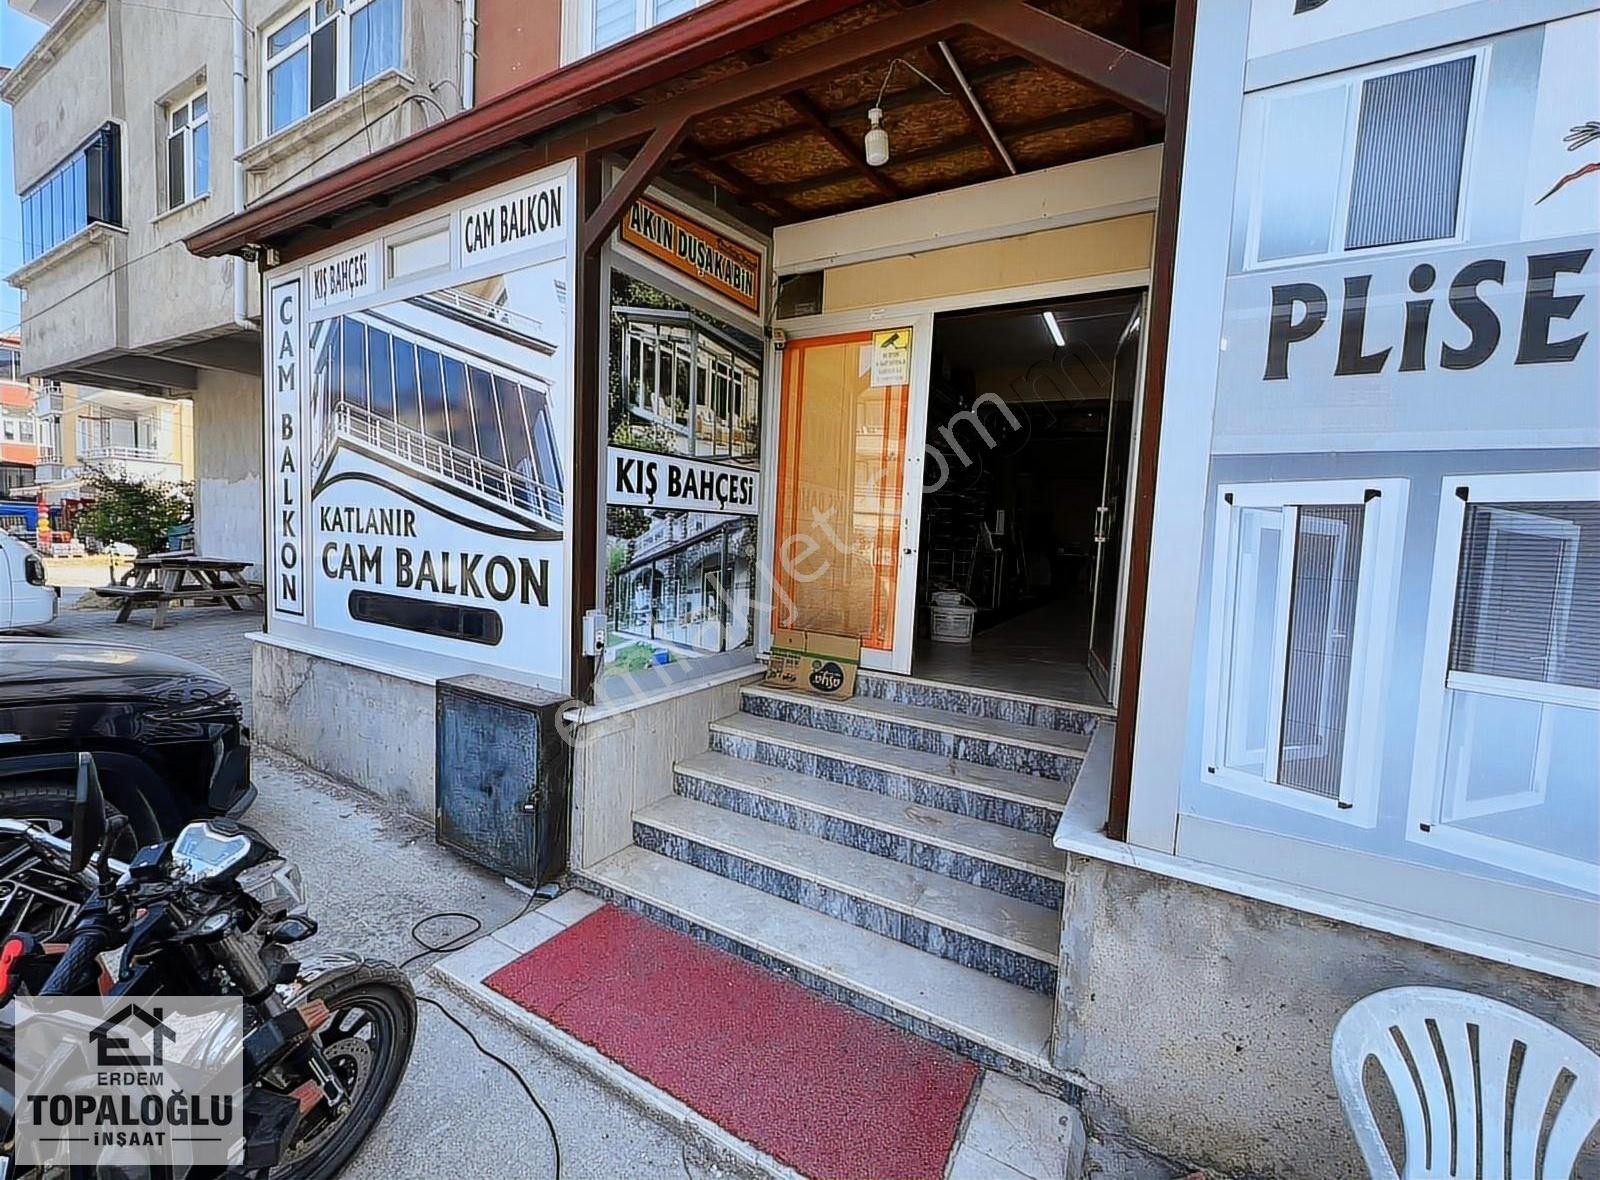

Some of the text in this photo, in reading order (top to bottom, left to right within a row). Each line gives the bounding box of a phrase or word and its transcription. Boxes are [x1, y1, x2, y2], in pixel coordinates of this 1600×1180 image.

[464, 186, 562, 253] CAM BALKON
[629, 201, 675, 253] AKIN
[313, 265, 328, 305] KIŞ
[278, 296, 297, 602] CAM BALKON
[615, 457, 658, 504] KIŞ
[320, 506, 416, 538] KATLANIR
[322, 542, 549, 607] CAM BALKON
